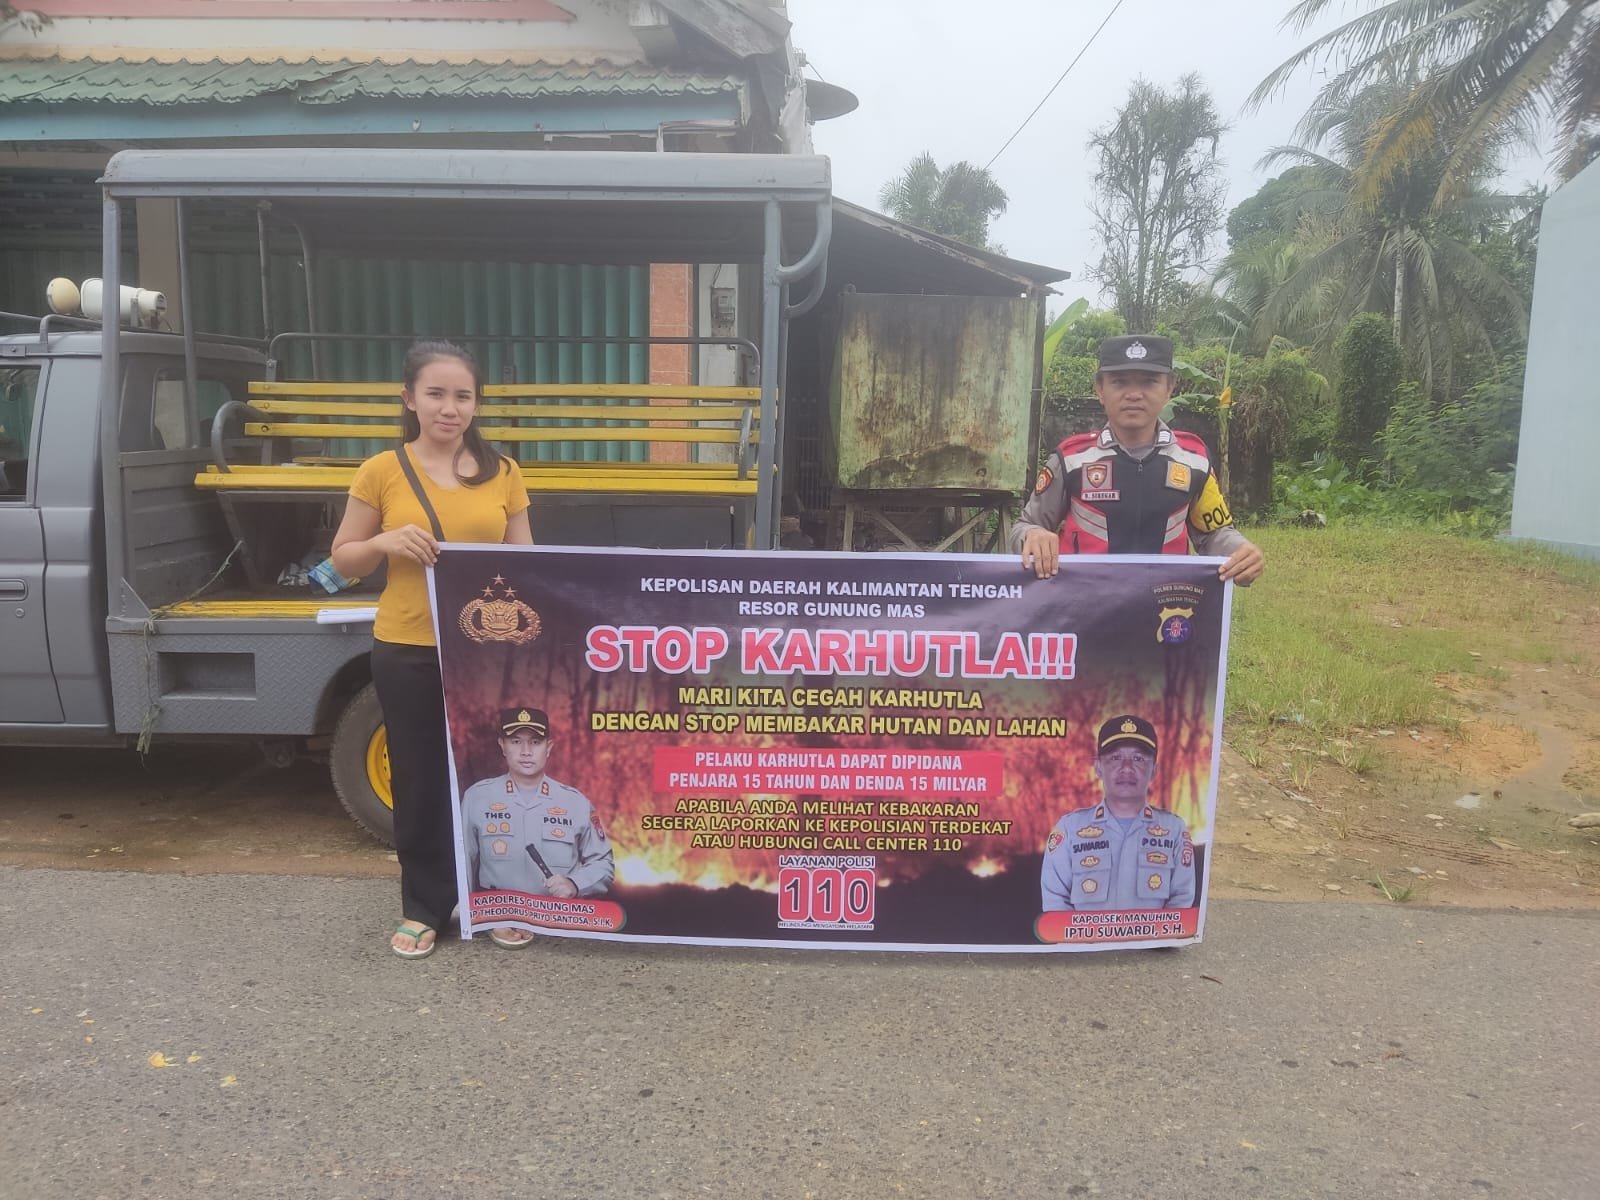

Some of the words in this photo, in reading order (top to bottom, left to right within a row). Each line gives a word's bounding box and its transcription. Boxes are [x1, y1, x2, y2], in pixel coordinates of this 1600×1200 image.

[641, 578, 743, 593] KEPOLISAN
[749, 580, 821, 594] DAERAH
[827, 582, 943, 597] KALIMANTAN
[948, 583, 1022, 599] TENGAH
[739, 601, 798, 616] RESOR
[804, 602, 882, 616] GUNUNG
[887, 603, 925, 618] MAS
[586, 625, 728, 674] STOP
[741, 628, 1077, 679] KARHUTLA!!!
[678, 686, 730, 705] MARI
[737, 687, 786, 706] KITA
[792, 688, 863, 707] CEGAH
[869, 690, 982, 709] KARHUTLA
[591, 712, 679, 731] DENGAN
[684, 713, 739, 733] STOP
[745, 715, 864, 735] MEMBAKAR
[871, 717, 941, 736] HUTAN
[948, 718, 991, 736] DAN
[996, 719, 1066, 738] LAHAN
[695, 752, 752, 768] PELAKU
[758, 753, 835, 769] KARHUTLA
[840, 754, 887, 769] DAPAT
[892, 754, 962, 770] DIPIDANA
[669, 773, 737, 789] PENJARA
[743, 774, 760, 789] 15
[766, 774, 815, 790] TAHUN
[820, 774, 849, 790] DAN
[855, 775, 904, 791] DENDA
[910, 776, 927, 791] 15
[933, 777, 987, 792] MILYAR
[485, 812, 511, 820] THEO
[676, 799, 746, 814] APABILA
[750, 800, 798, 815] ANDA
[803, 801, 874, 816] MELIHAT
[879, 802, 979, 817] KEBAKARAN
[543, 817, 573, 826] POLRI
[642, 816, 706, 831] SEGERA
[711, 817, 799, 832] LAPORKAN
[805, 818, 824, 832] KE
[829, 818, 925, 834] KEPOLISIAN
[929, 820, 1011, 836] TERDEKAT
[692, 834, 734, 849] ATAU
[739, 835, 818, 850] HUBUNGI
[822, 836, 861, 850] CALL
[865, 837, 928, 851] CENTER
[933, 838, 962, 852] 110
[1072, 840, 1110, 853] SUWARDI
[1142, 837, 1174, 848] POLRI
[780, 856, 835, 867] LAYANAN
[838, 856, 875, 868] POLISI
[474, 895, 524, 906] KAPOLRES
[526, 899, 569, 912] GUNUNG
[572, 904, 594, 914] MAS
[785, 877, 869, 914] 110
[1072, 913, 1121, 924] KAPOLSEK
[1124, 912, 1180, 923] MANUHING
[1065, 926, 1094, 938] IPTU
[1098, 924, 1158, 938] SUWARDI,
[1162, 924, 1185, 934] S.H.
